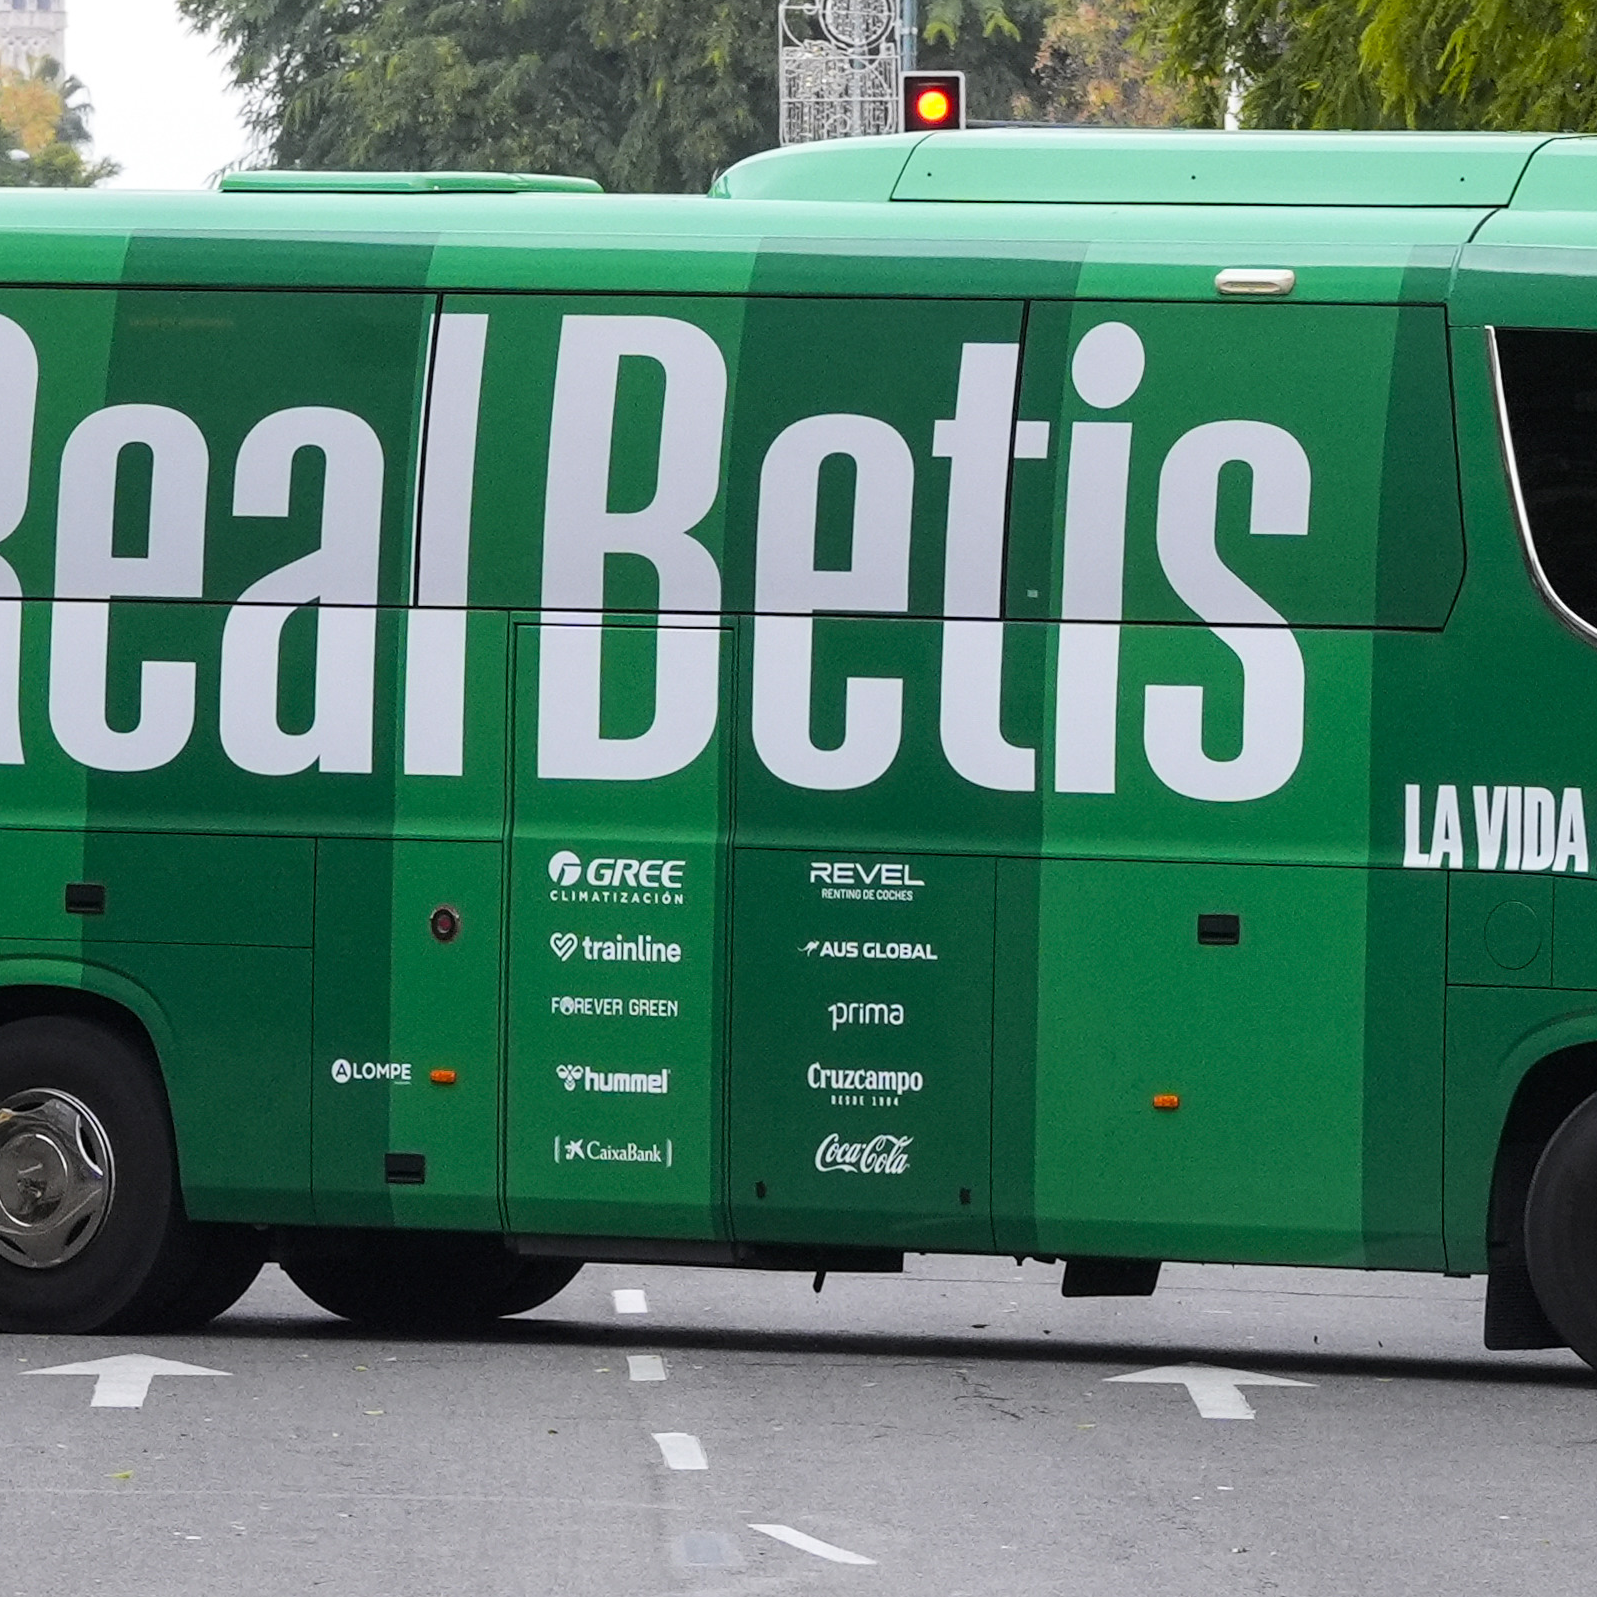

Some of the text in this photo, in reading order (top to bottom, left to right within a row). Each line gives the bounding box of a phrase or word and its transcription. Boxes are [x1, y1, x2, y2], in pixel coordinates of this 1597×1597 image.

[537, 313, 1312, 802] Betis
[1403, 784, 1464, 870] LA
[1472, 785, 1589, 873] VIDA
[585, 857, 687, 889] GREE
[809, 861, 926, 887] REVEL
[549, 889, 684, 905] CLIMATIZACIÓN
[821, 887, 914, 902] RENTING DE COCHES
[581, 933, 682, 963] trainline
[819, 940, 939, 961] AUS GLOBAL
[551, 995, 679, 1018] FOREVER GREEN
[827, 1002, 905, 1032] prima
[584, 1065, 668, 1094] hummel
[806, 1061, 924, 1096] Cruzcampo
[830, 1094, 865, 1106] DESDE
[586, 1140, 662, 1163] CaixaBank
